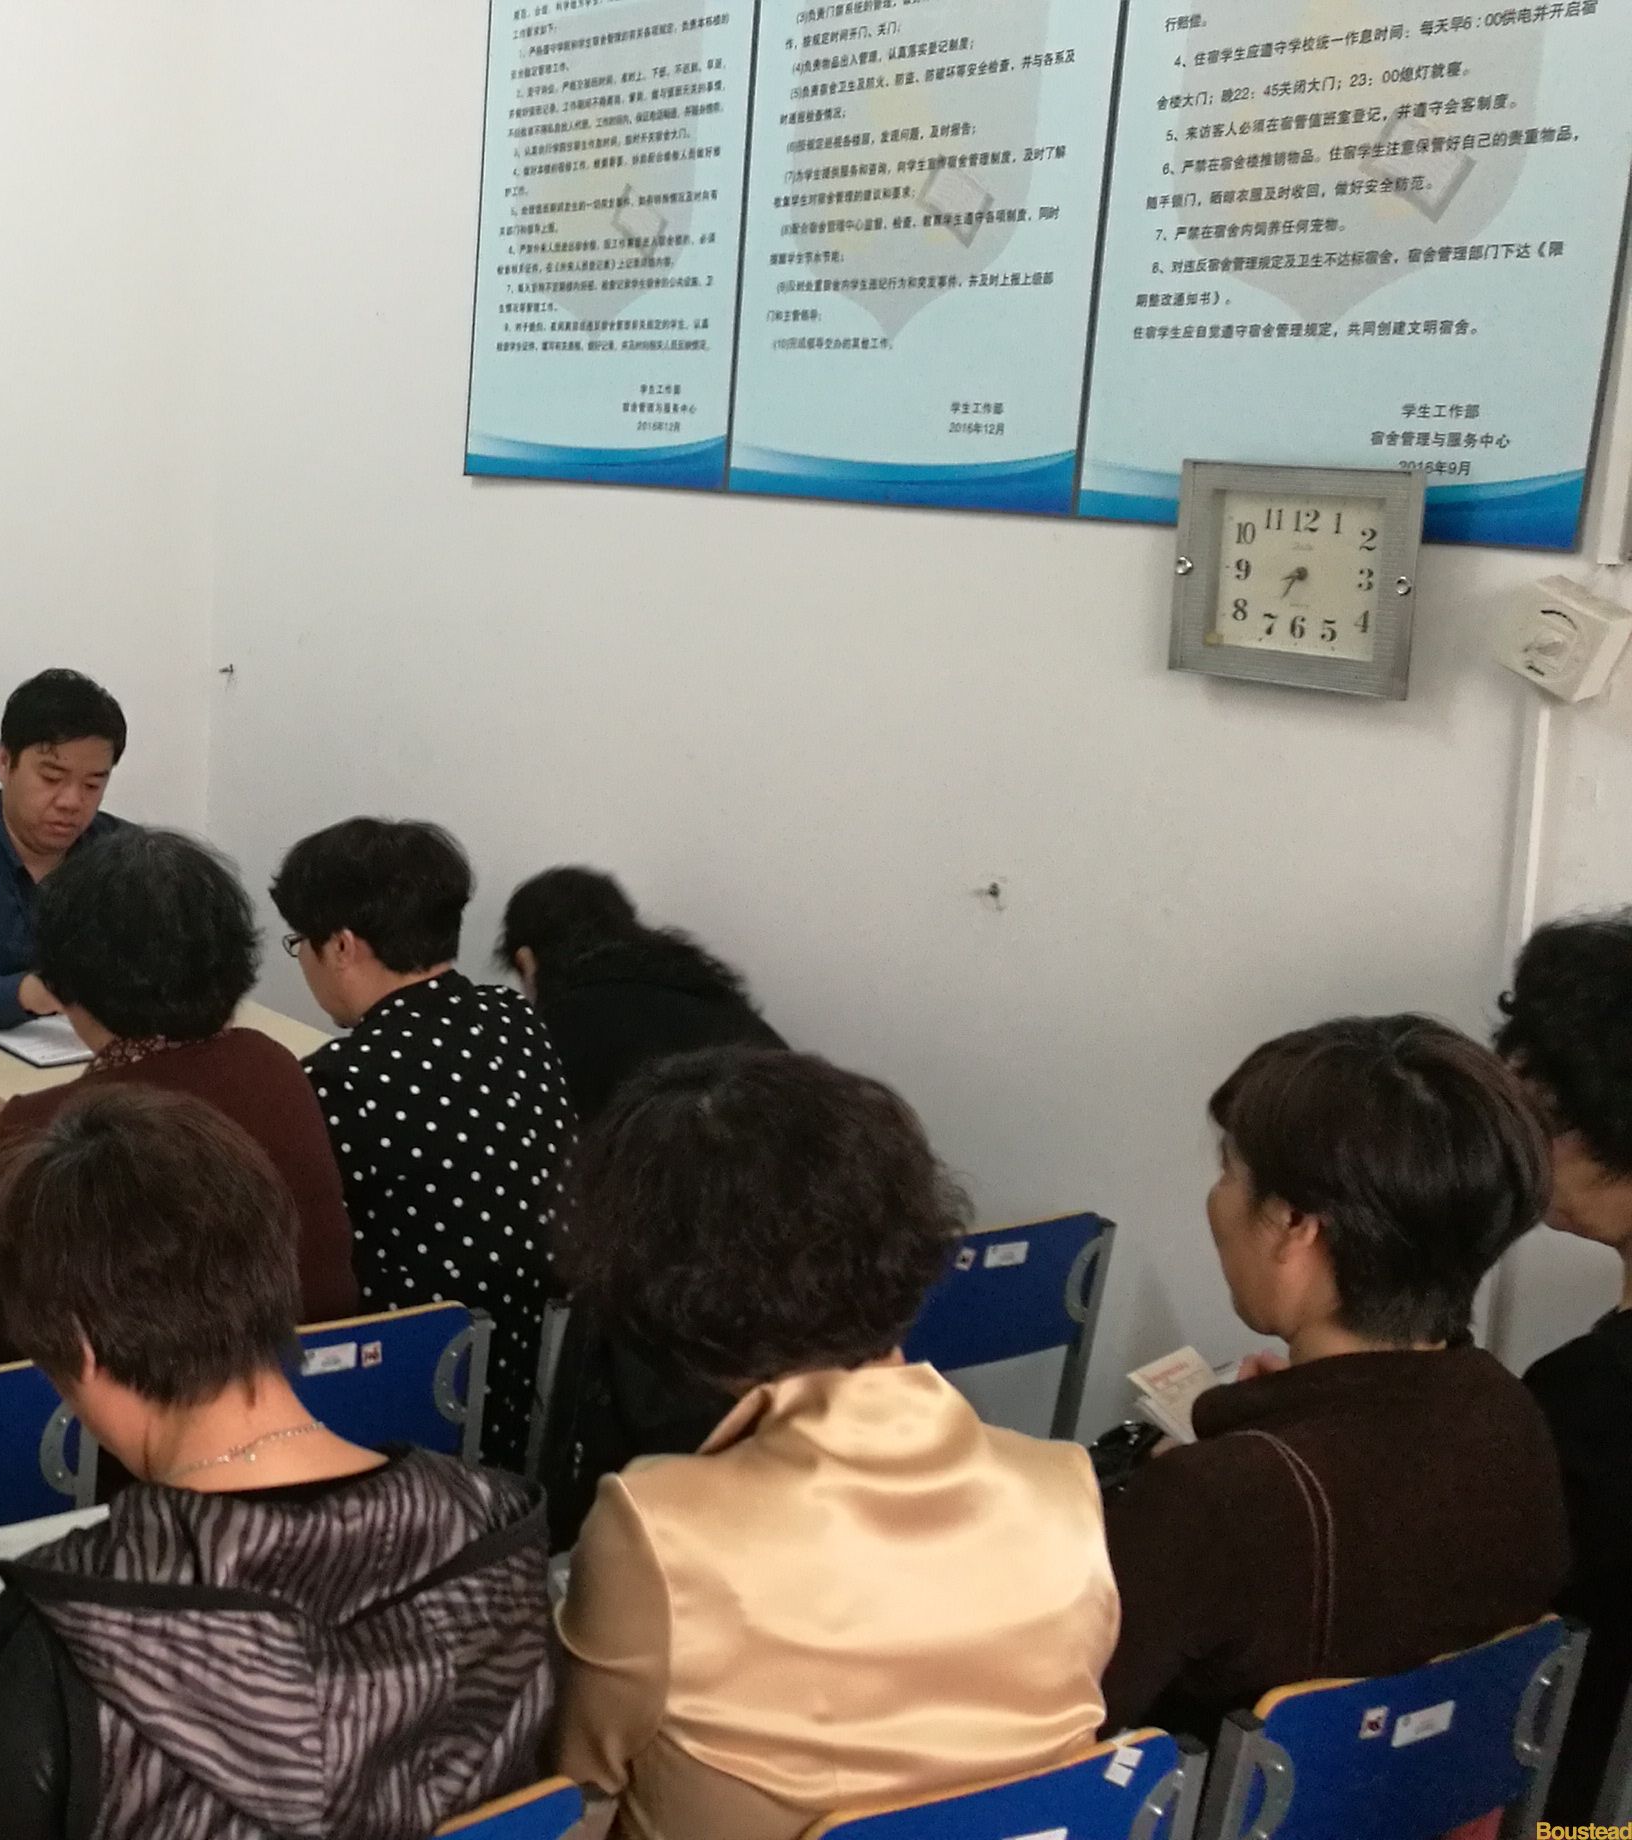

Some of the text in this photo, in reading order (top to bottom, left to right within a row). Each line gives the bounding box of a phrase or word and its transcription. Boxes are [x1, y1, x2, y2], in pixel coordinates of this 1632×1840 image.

[1401, 403, 1480, 419] 学生工作部
[1371, 431, 1510, 449] 宿舍管理与服务中心
[1265, 508, 1283, 530] 11
[1293, 509, 1320, 532] 12
[1333, 512, 1343, 534] 1
[1235, 521, 1256, 544] 10
[1359, 528, 1378, 551] 2
[1235, 558, 1252, 580] 9
[1358, 568, 1374, 591] 3
[1232, 598, 1248, 621] 8
[1263, 612, 1278, 636] 7
[1290, 615, 1306, 639] 6
[1321, 619, 1337, 642] 5
[1353, 610, 1370, 633] 4
